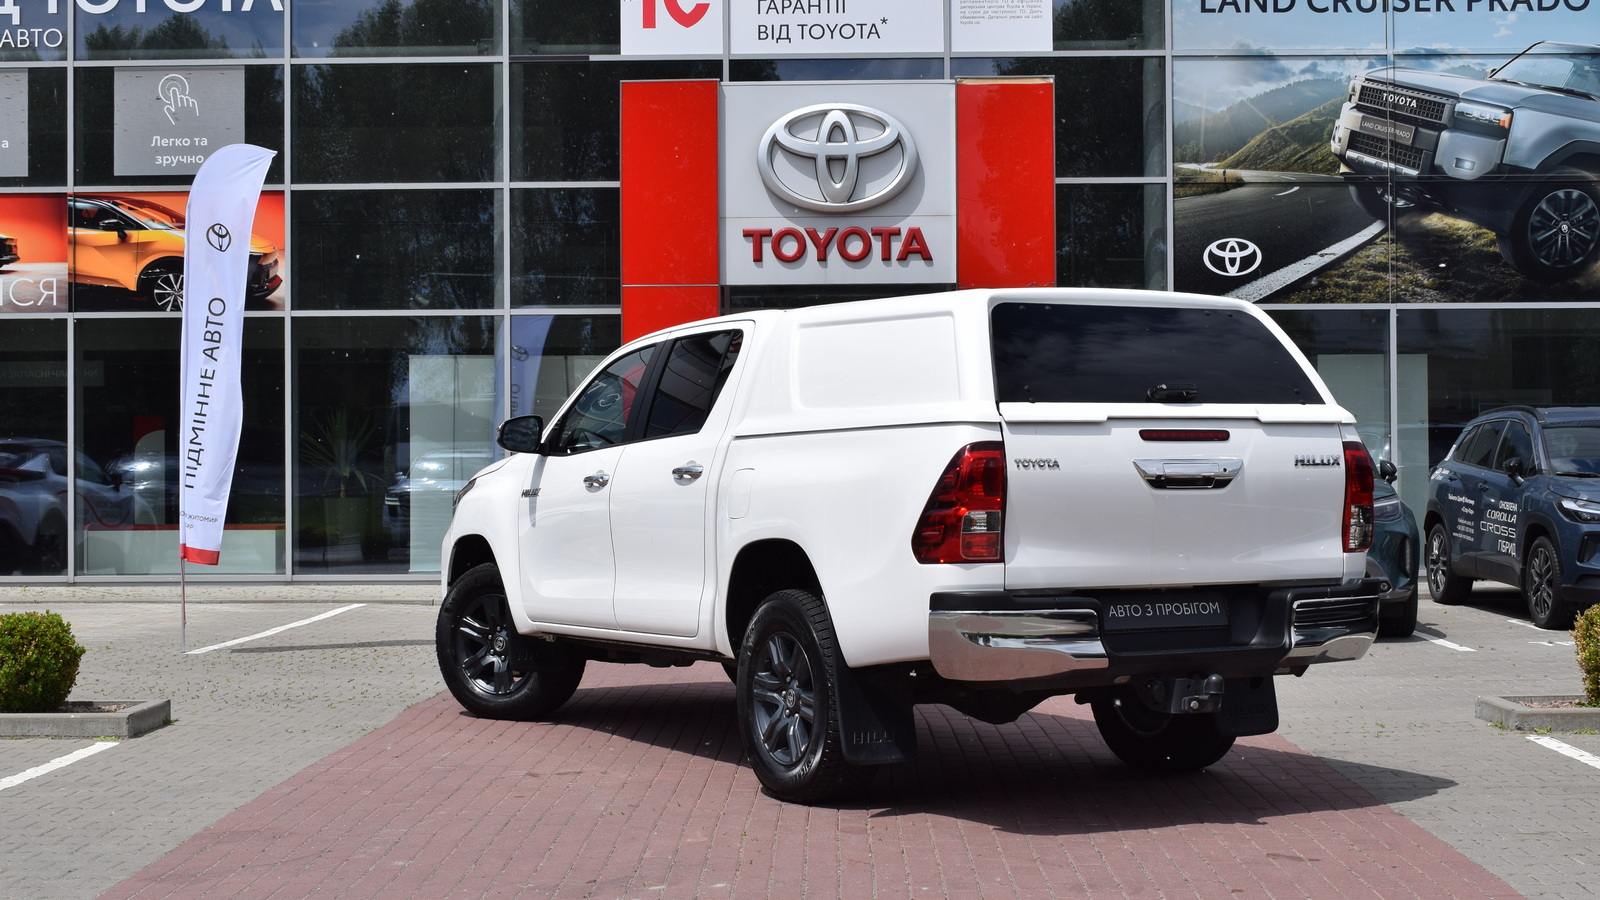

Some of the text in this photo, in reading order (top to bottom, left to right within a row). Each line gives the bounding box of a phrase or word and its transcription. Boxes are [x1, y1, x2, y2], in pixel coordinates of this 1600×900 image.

[0, 28, 63, 48] АВТО
[757, 24, 791, 44] ВІД
[1383, 93, 1417, 108] TOYOTA
[1361, 120, 1374, 129] LAND
[150, 135, 208, 148] Легко та
[154, 153, 205, 166] зручно
[742, 226, 934, 263] TOYOTA
[0, 277, 57, 307] СЯ
[203, 297, 227, 363] АВТО
[1013, 458, 1061, 471] TOYOTA
[1294, 453, 1341, 468] HILUX
[1486, 509, 1517, 524] COROLLA
[1480, 520, 1516, 539] CROSS
[1108, 605, 1141, 618] АВТО
[1155, 601, 1221, 616] ПРОБІГОМ
